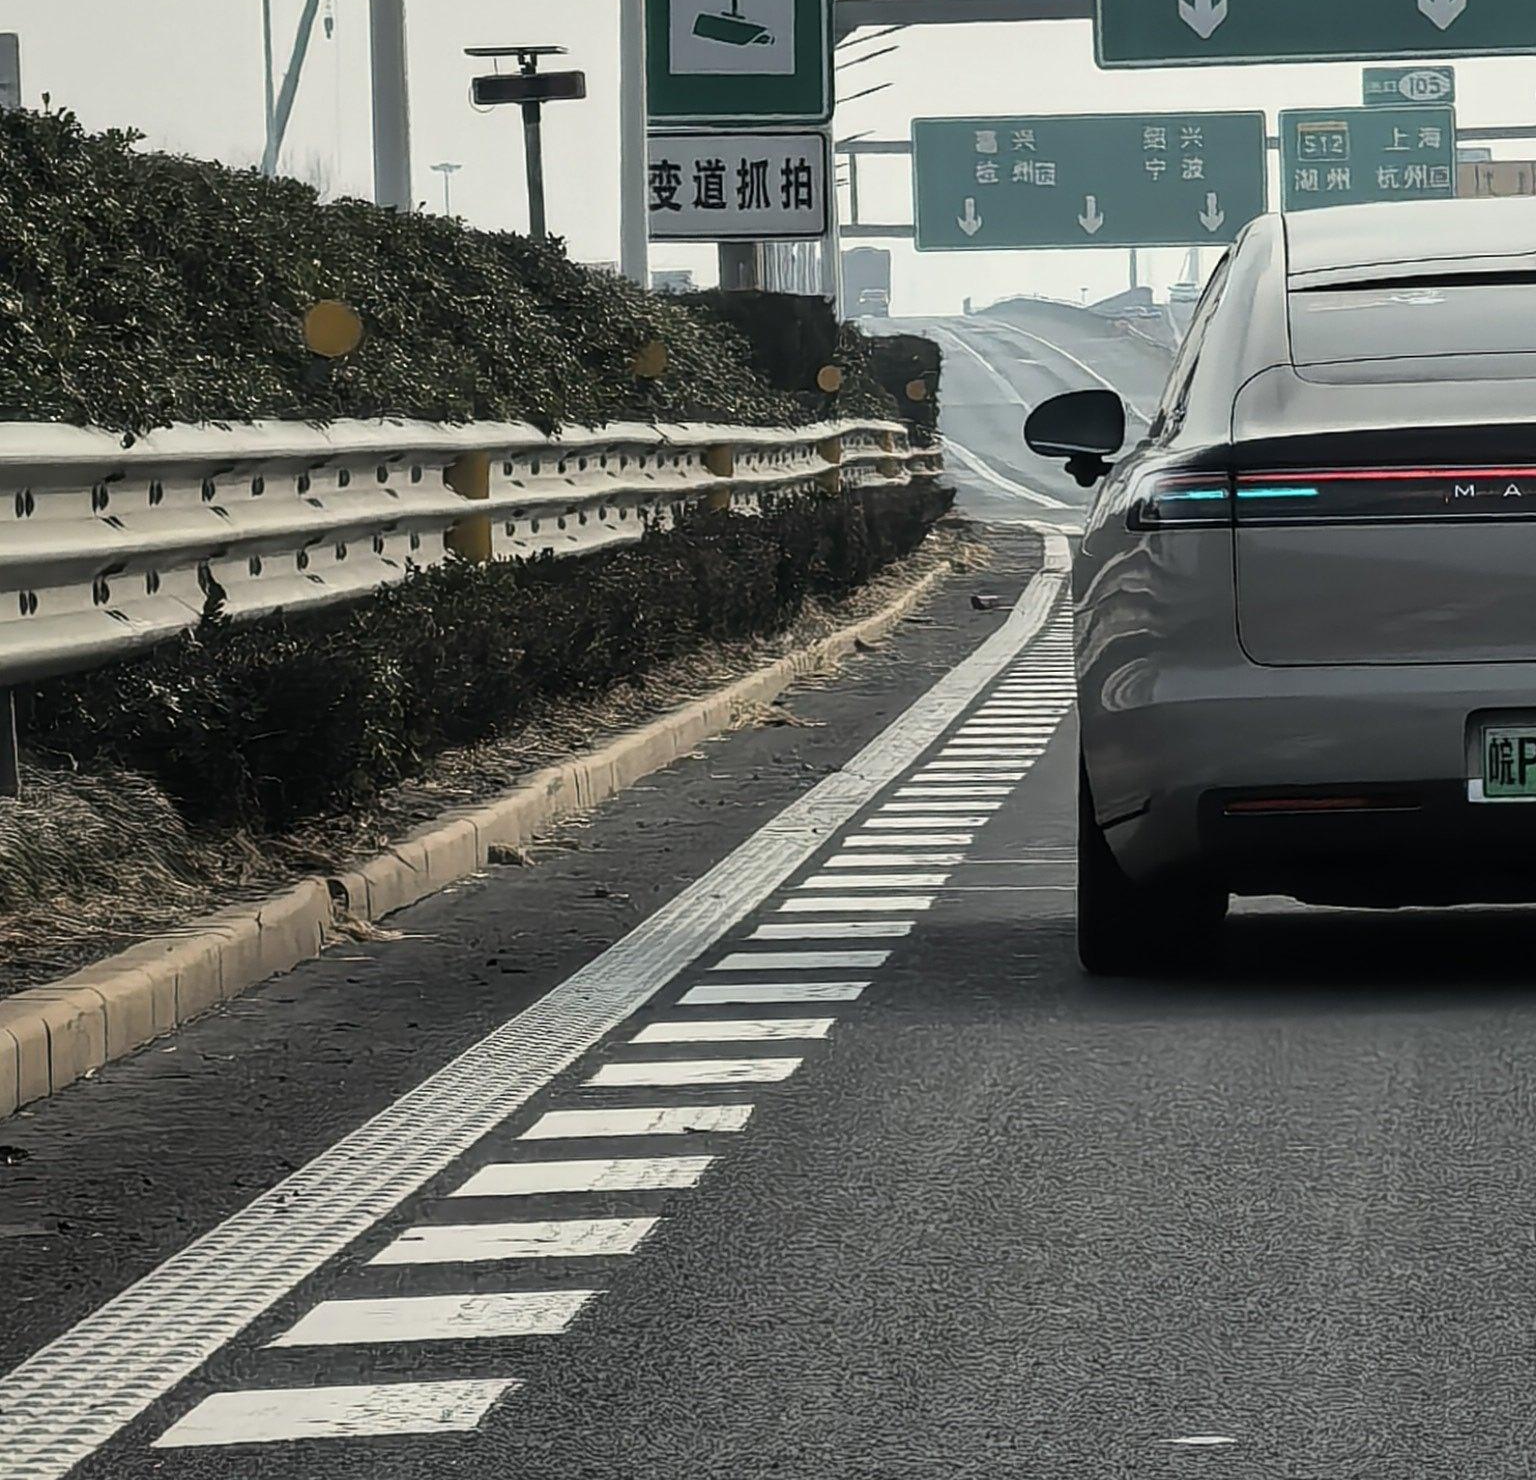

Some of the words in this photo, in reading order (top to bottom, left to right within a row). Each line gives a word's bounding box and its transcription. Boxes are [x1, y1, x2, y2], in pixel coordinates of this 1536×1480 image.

[1409, 76, 1441, 97] 105
[648, 157, 813, 212] 变道抓拍
